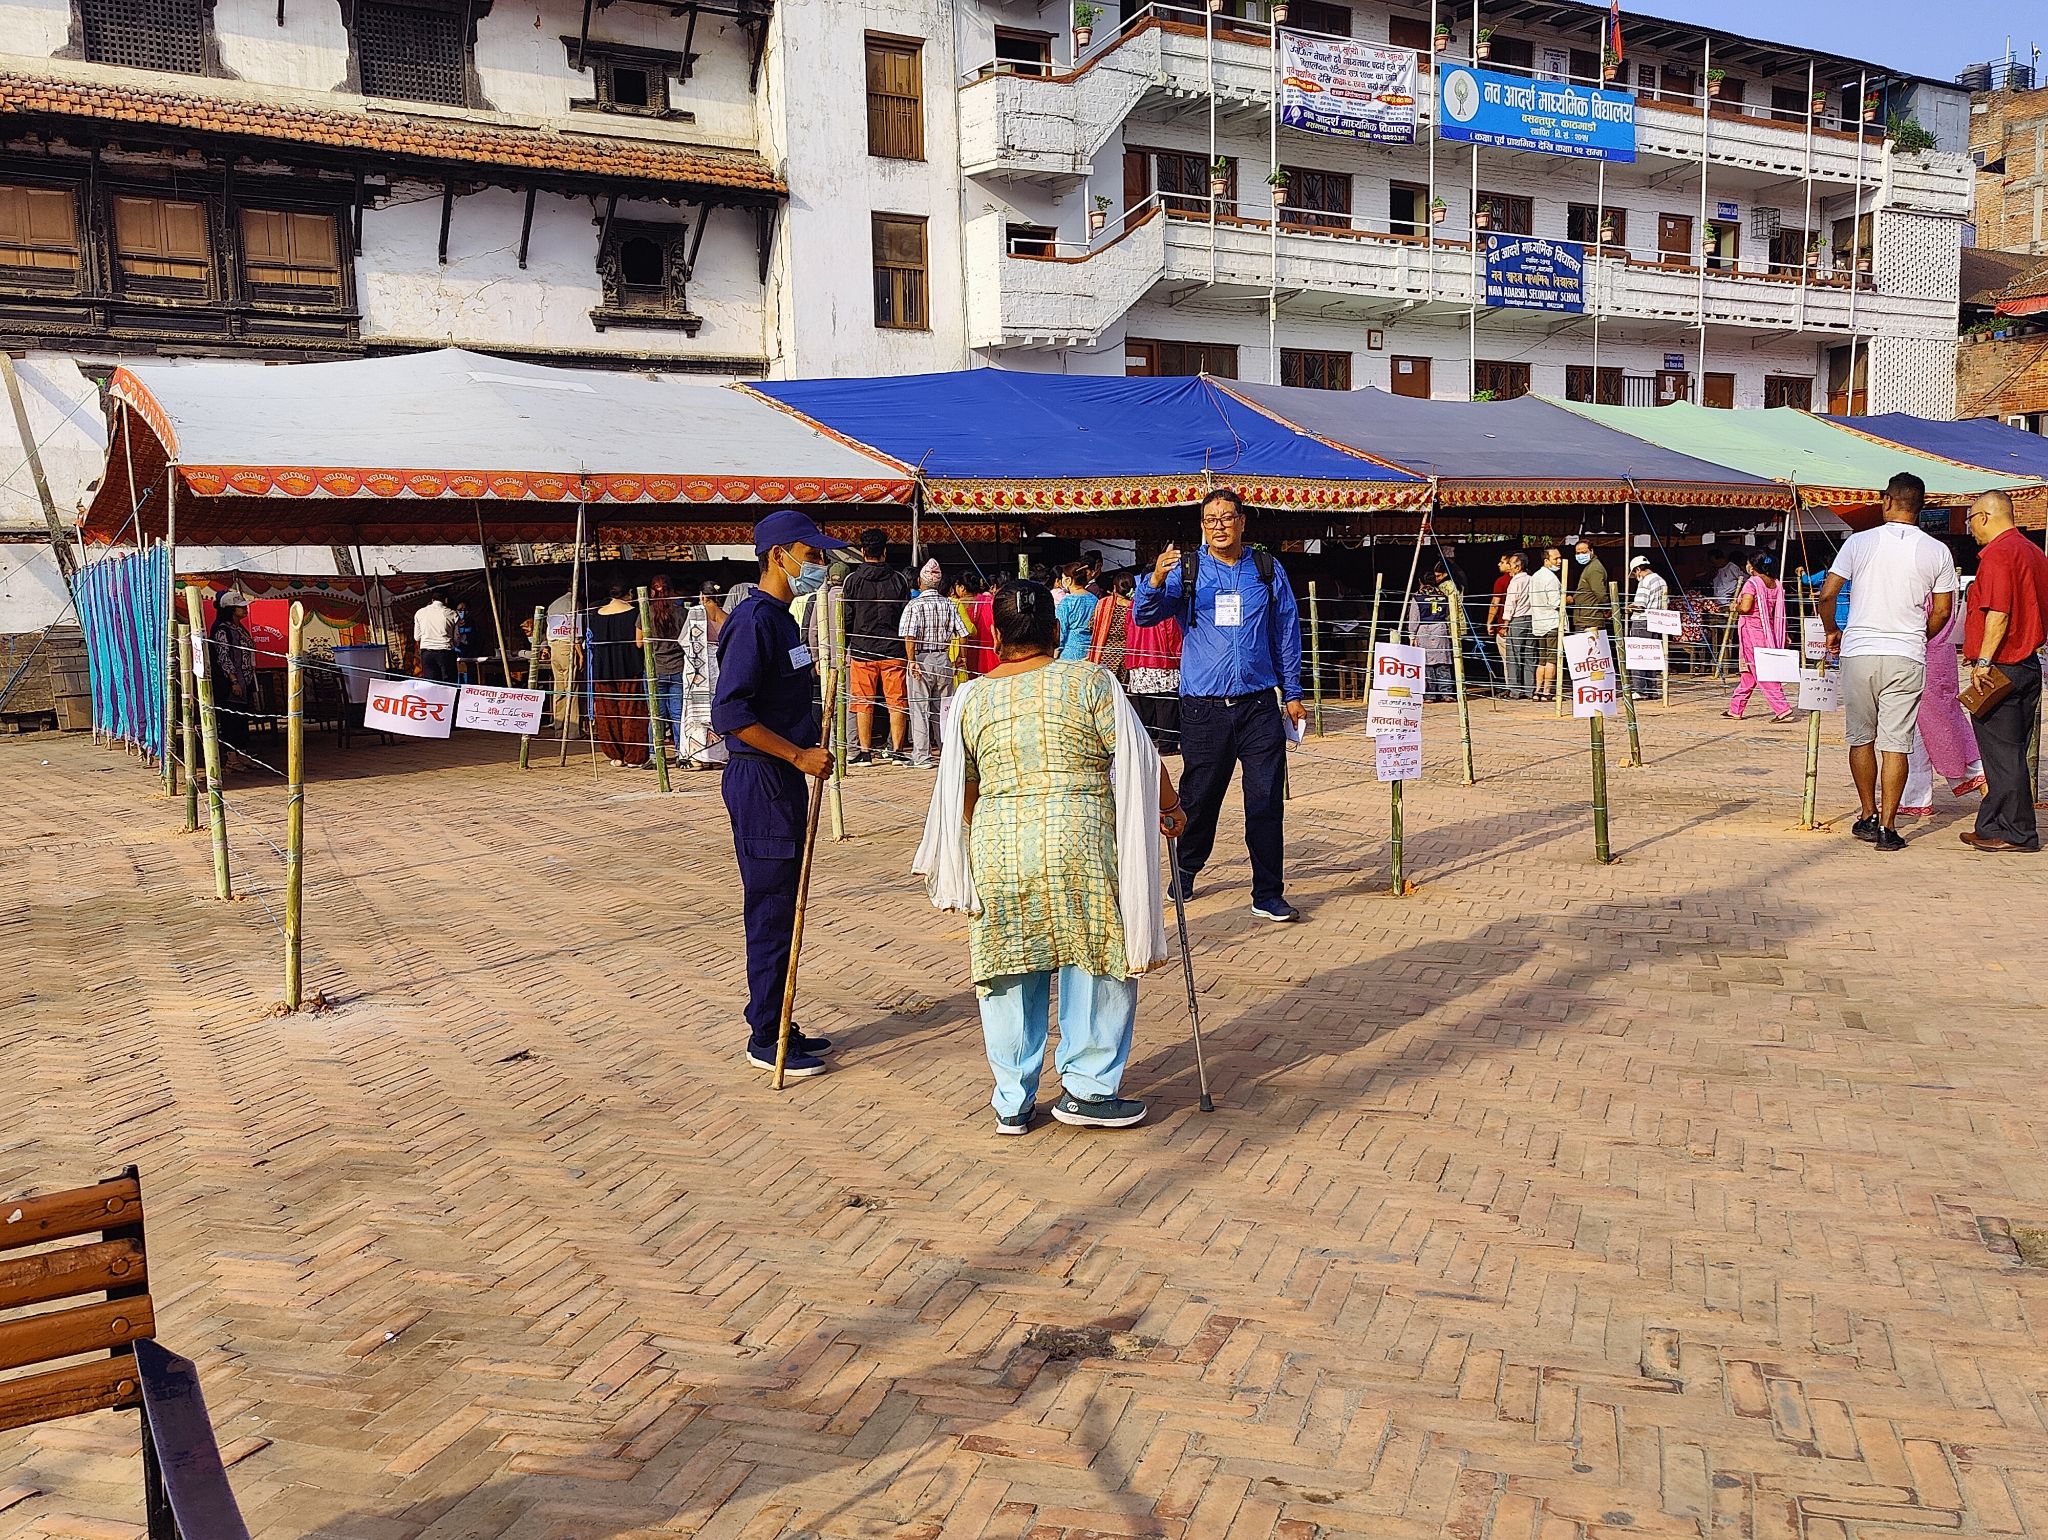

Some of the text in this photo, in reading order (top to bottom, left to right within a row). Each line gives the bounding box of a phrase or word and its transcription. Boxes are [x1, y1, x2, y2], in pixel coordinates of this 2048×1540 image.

[1484, 82, 1634, 124] नव आदर्श माध्यमिक विद्यालय
[1316, 112, 1340, 126] आदर्श
[1341, 118, 1377, 133] माध्यमिक
[1378, 122, 1412, 134] विद्यालय
[1488, 250, 1500, 264] नव
[1501, 239, 1520, 259] आदर्श
[1521, 239, 1554, 257] माध्यमिक
[1554, 246, 1582, 274] विद्यालय
[1488, 285, 1581, 303] NAVA ADARSHA SECONDARY SCHOOL
[232, 472, 266, 483] WELCOME
[277, 472, 311, 483] WELCOME
[322, 473, 356, 483] WELCOME
[366, 473, 399, 484] WELCOME
[410, 474, 442, 485] WELCOME
[451, 475, 483, 487] WELCOME
[493, 477, 524, 488] WELCOME
[533, 478, 563, 489] WELCOME
[611, 479, 640, 489] WELCOME
[650, 479, 677, 490] WELCOME
[686, 480, 714, 490] WELCOME
[723, 480, 750, 490] WELCOME
[758, 481, 785, 491] WELCOME
[794, 481, 821, 491] WELCOME
[828, 481, 854, 491] WELCOME
[862, 483, 888, 493] WELCOME
[1378, 656, 1422, 680] भित्र
[1574, 656, 1611, 674] महिला
[465, 687, 498, 698] मतदाता
[1577, 686, 1615, 705] भित्र
[373, 694, 449, 722] बाहिर
[1371, 716, 1419, 728] मतदान केन्द्र
